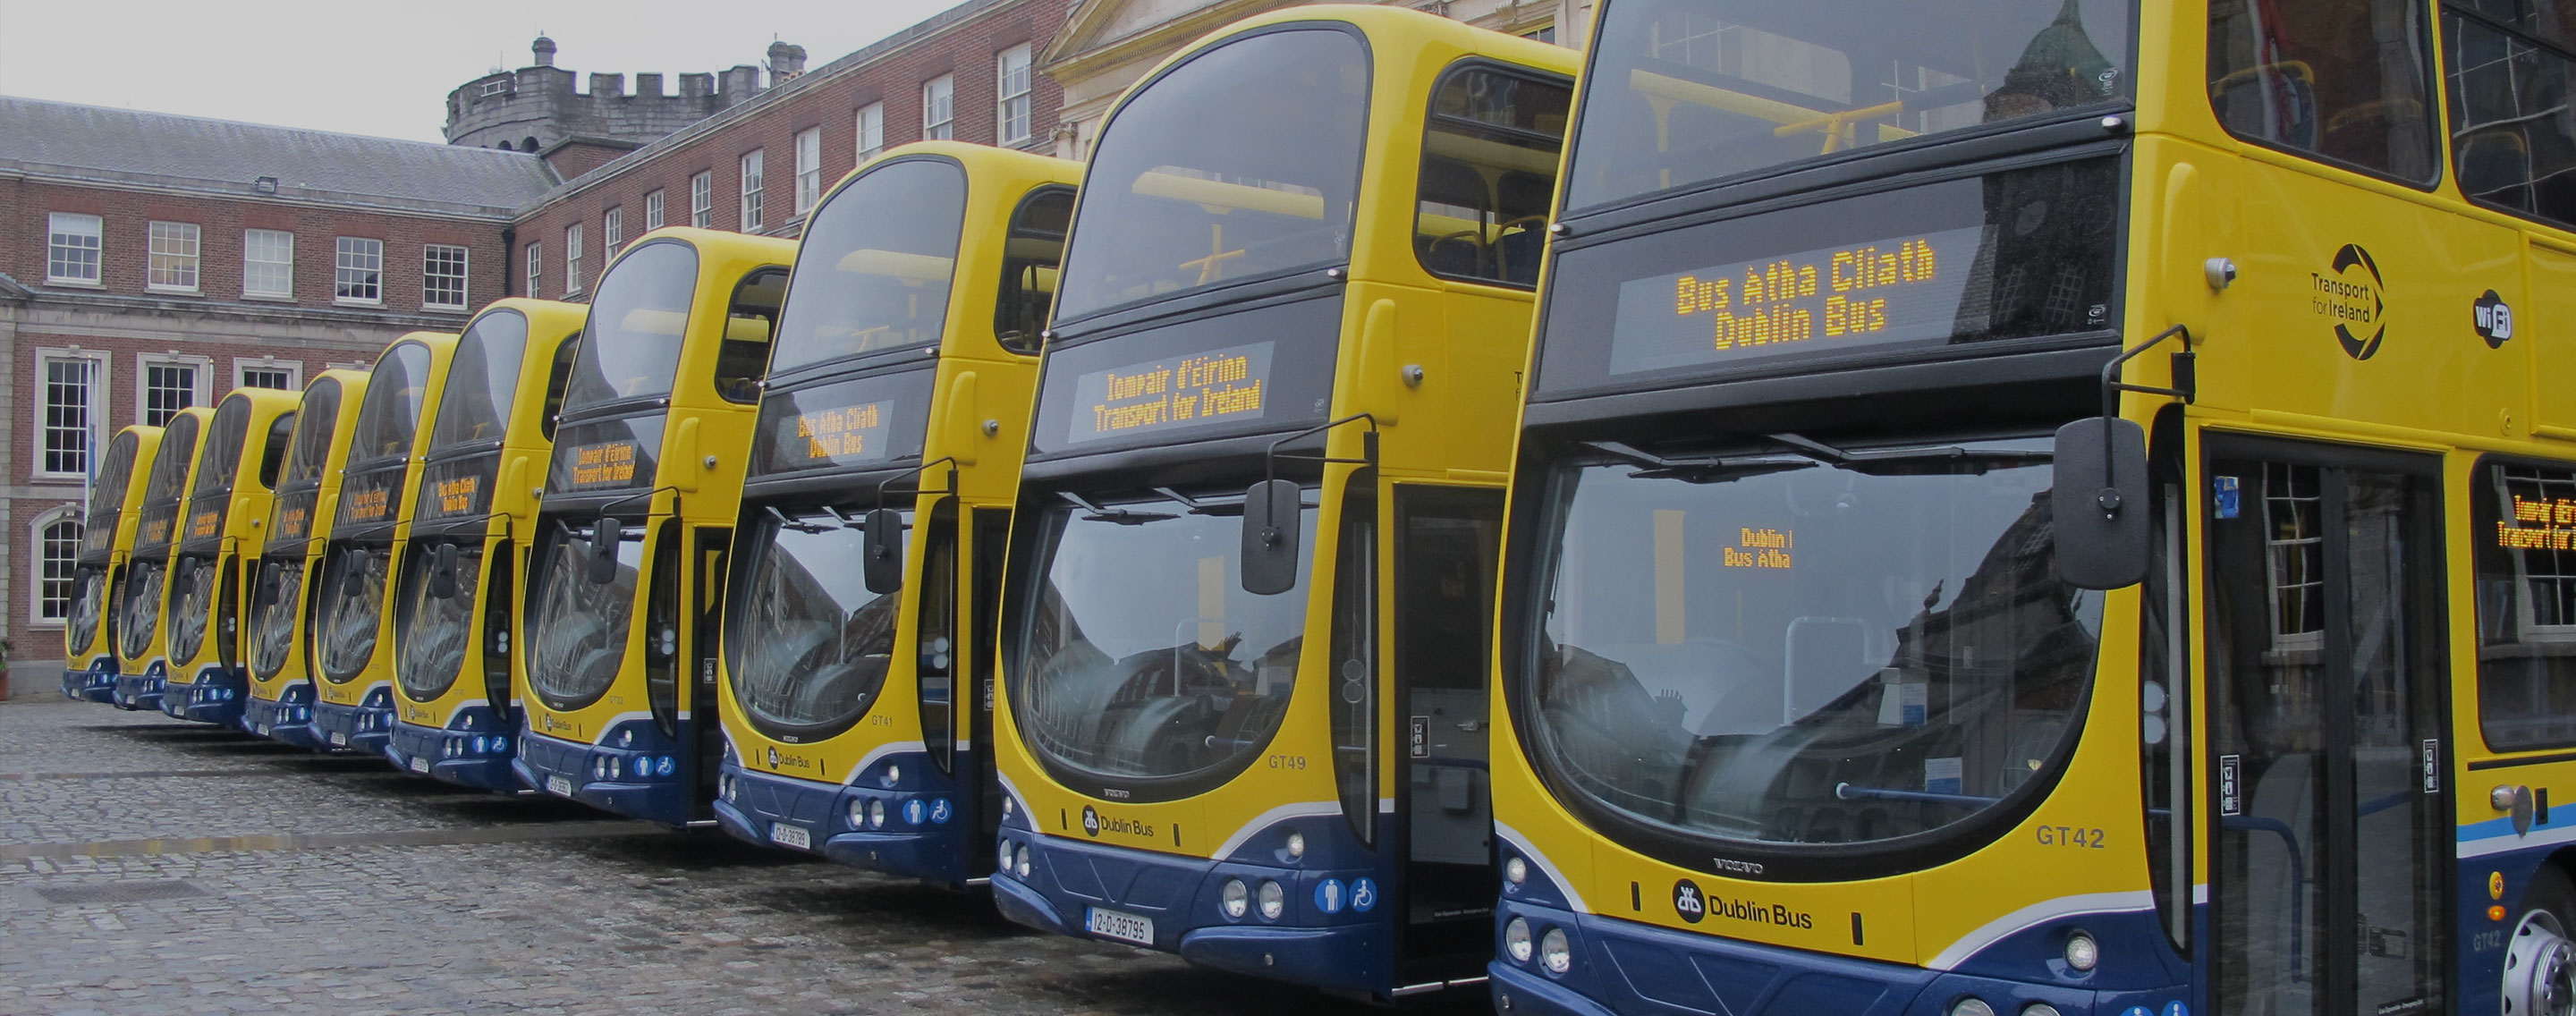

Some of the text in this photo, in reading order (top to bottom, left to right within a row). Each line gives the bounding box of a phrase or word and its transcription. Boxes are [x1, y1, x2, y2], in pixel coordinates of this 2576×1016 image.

[1677, 276, 1730, 314] Bus
[1832, 239, 1935, 292] Cliath
[2311, 273, 2369, 301] Transport
[1715, 294, 1886, 350] Dublin Bus
[2313, 297, 2370, 323] for Ireland
[1106, 365, 1171, 401] Iompair
[1094, 378, 1261, 432] Transport for Ireland
[798, 415, 816, 437] Bus
[846, 404, 878, 430] Cliath
[809, 432, 863, 458] Dublin Bus
[1741, 528, 1785, 547] Dublin
[2497, 521, 2551, 548] Transport
[2553, 525, 2571, 549] for
[1724, 547, 1753, 566] Bus
[872, 715, 893, 726] GT41
[778, 753, 810, 769] Dublin Bus
[1268, 755, 1306, 770] GT49
[1100, 816, 1154, 836] Dublin Bus
[2036, 825, 2105, 849] GT42
[1713, 858, 1764, 875] VOLVO
[1708, 895, 1812, 929] Dublin Bus
[1095, 912, 1145, 940] 12-D-38795
[2474, 930, 2500, 951] GT42
